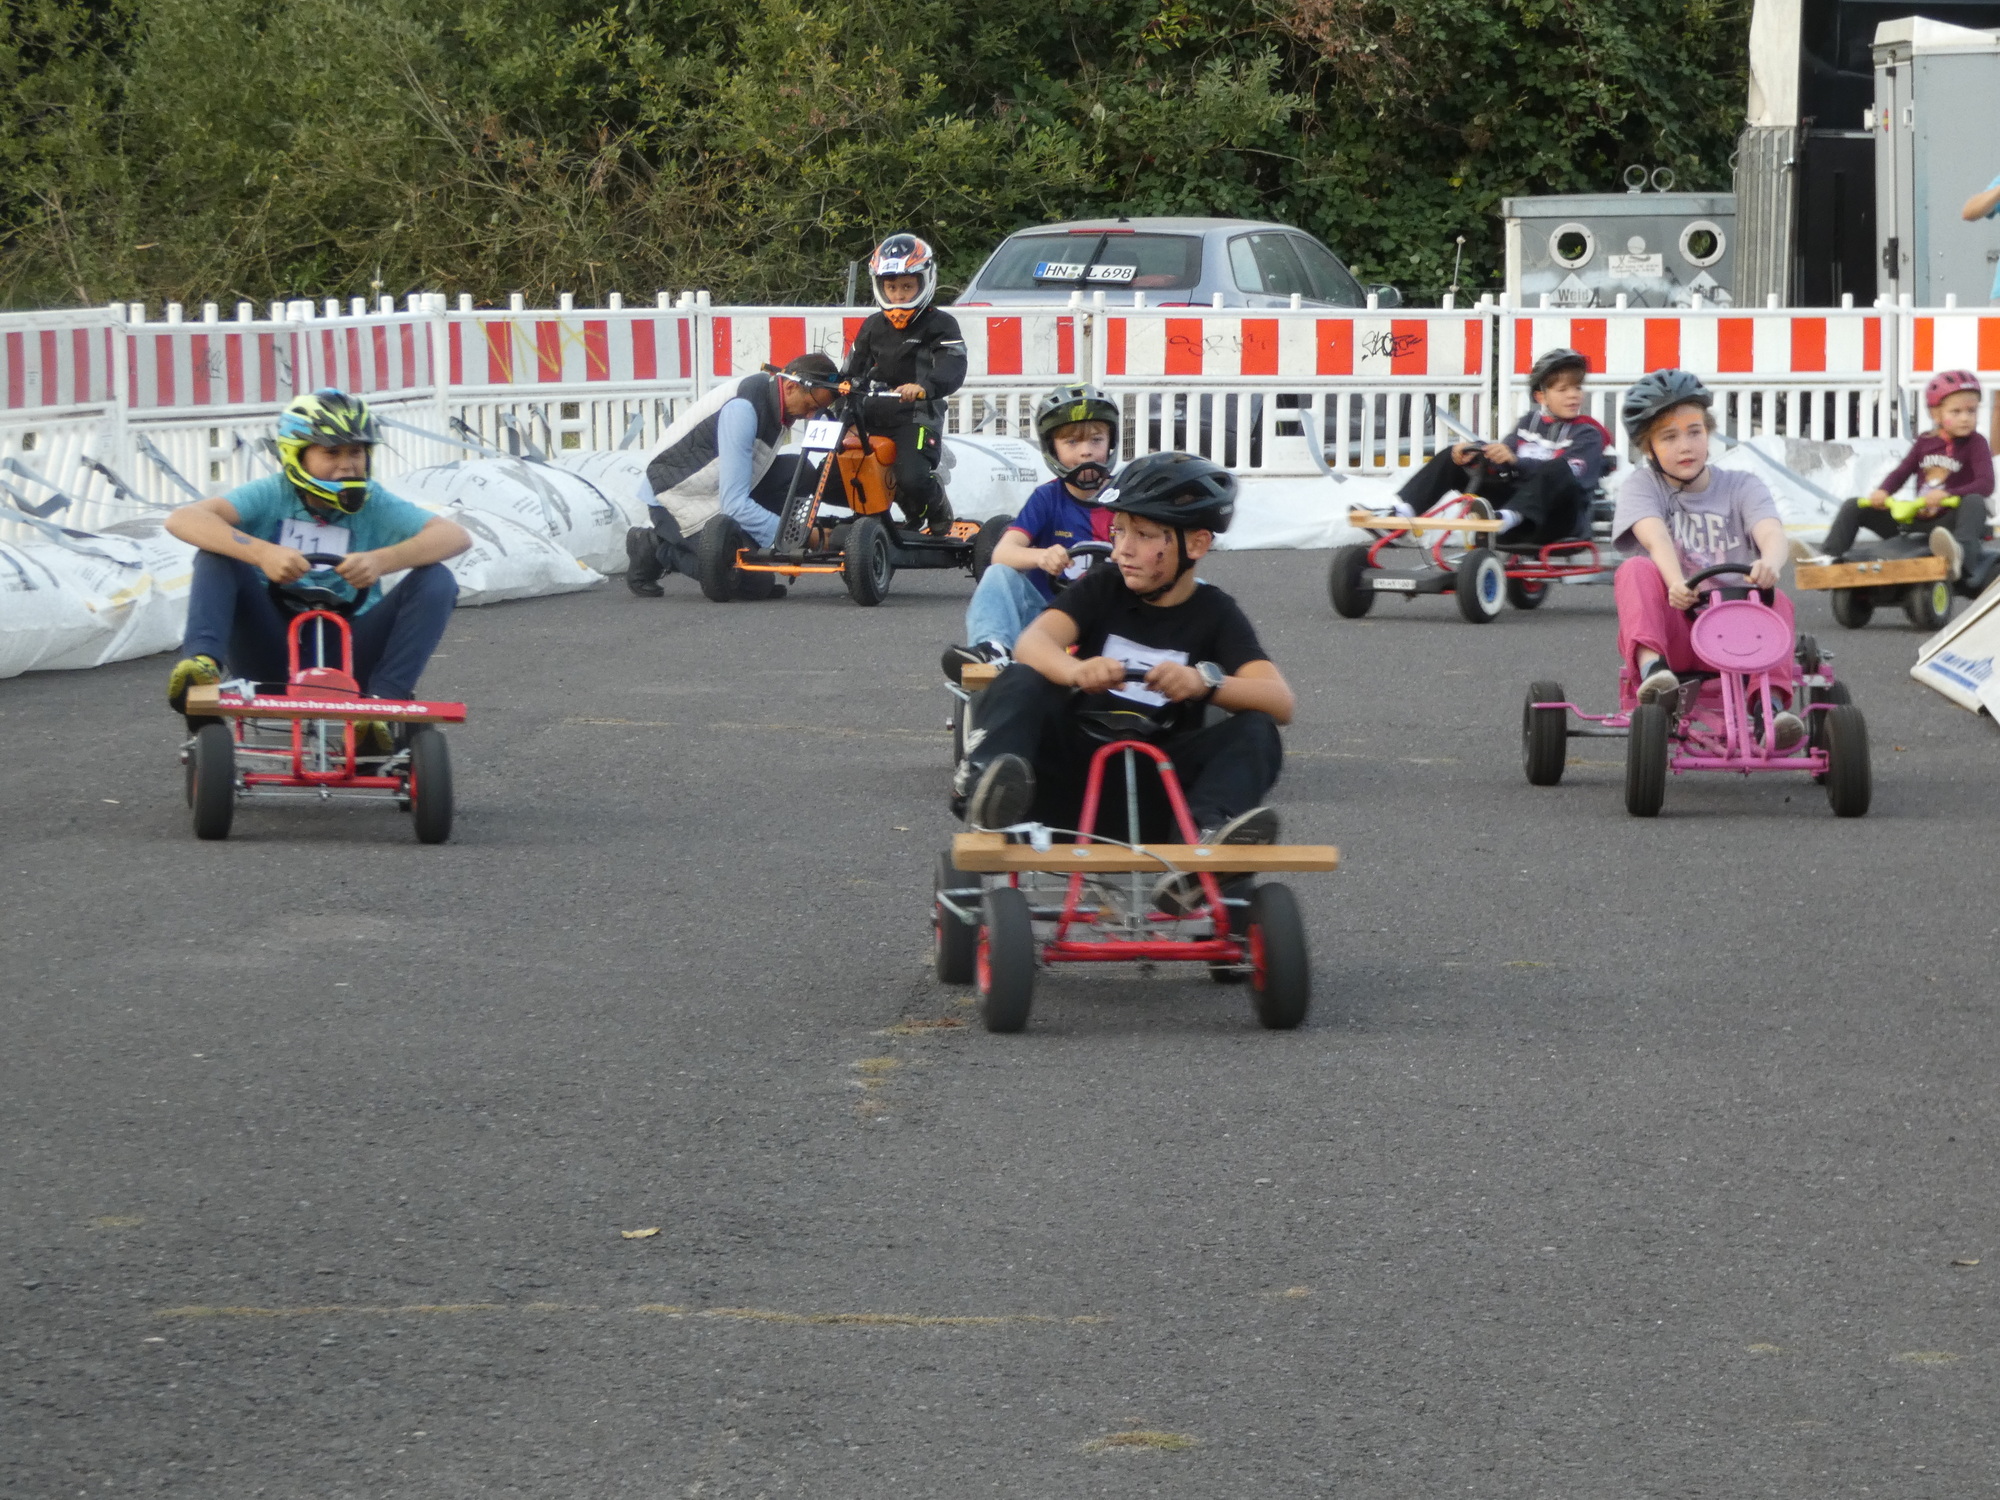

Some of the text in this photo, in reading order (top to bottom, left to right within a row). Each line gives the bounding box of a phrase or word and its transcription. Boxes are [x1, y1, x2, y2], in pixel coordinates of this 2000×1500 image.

[1045, 265, 1068, 277] HN
[1101, 268, 1132, 279] 698
[808, 427, 828, 442] 41
[1673, 511, 1740, 554] NGEL
[218, 697, 428, 714] wwakkuschraubercup.de
